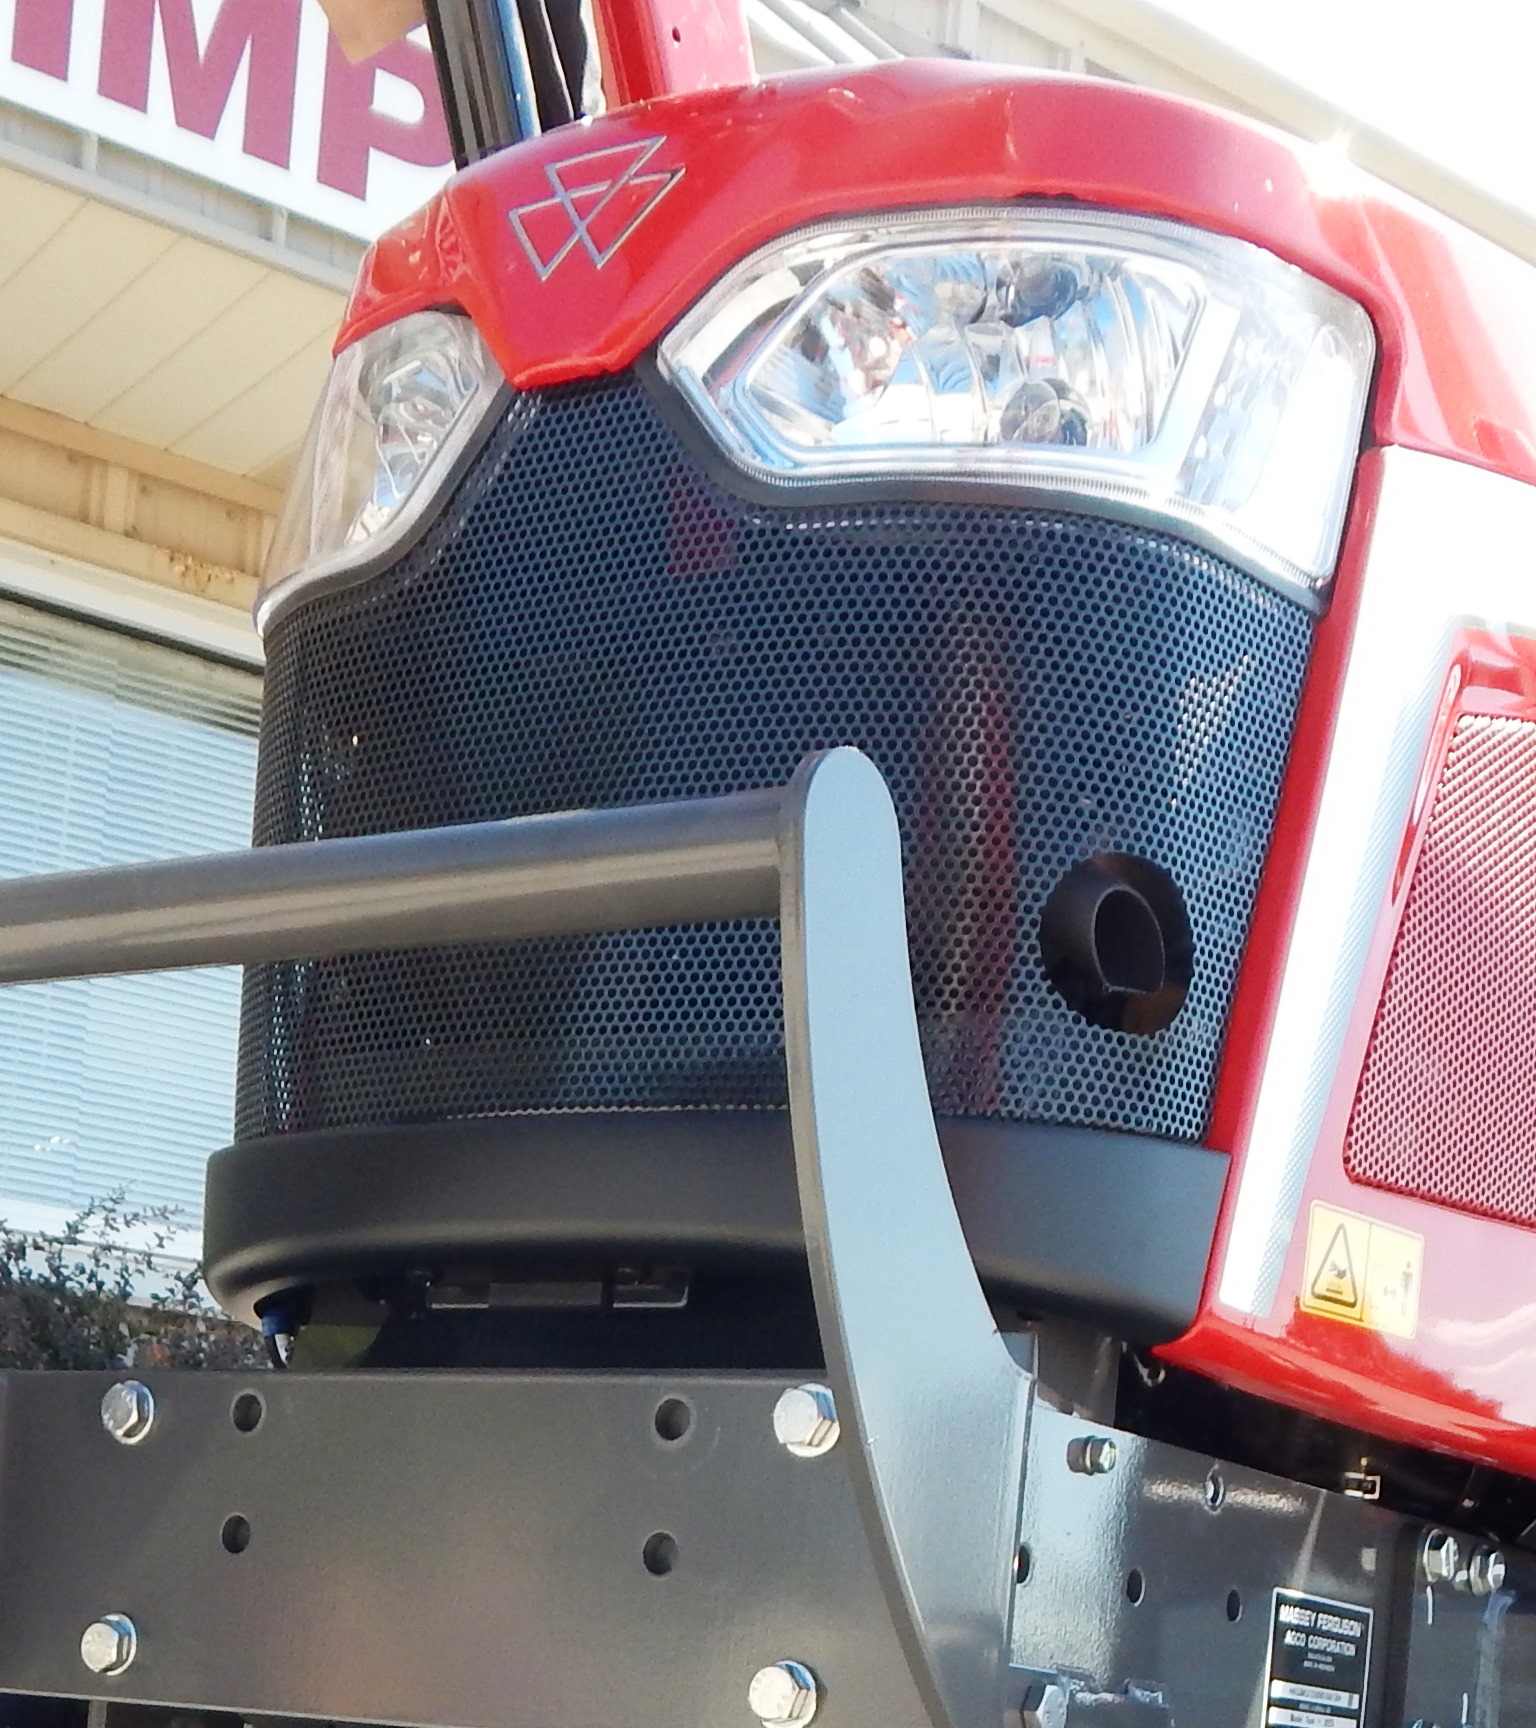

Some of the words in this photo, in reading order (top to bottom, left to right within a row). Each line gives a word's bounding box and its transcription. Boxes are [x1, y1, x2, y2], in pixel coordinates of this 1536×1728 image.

[1279, 1604, 1317, 1627] MASSEY
[1317, 1612, 1361, 1638] FERGUSON
[1285, 1630, 1307, 1647] AGCO
[1308, 1634, 1356, 1657] CORPORATION
